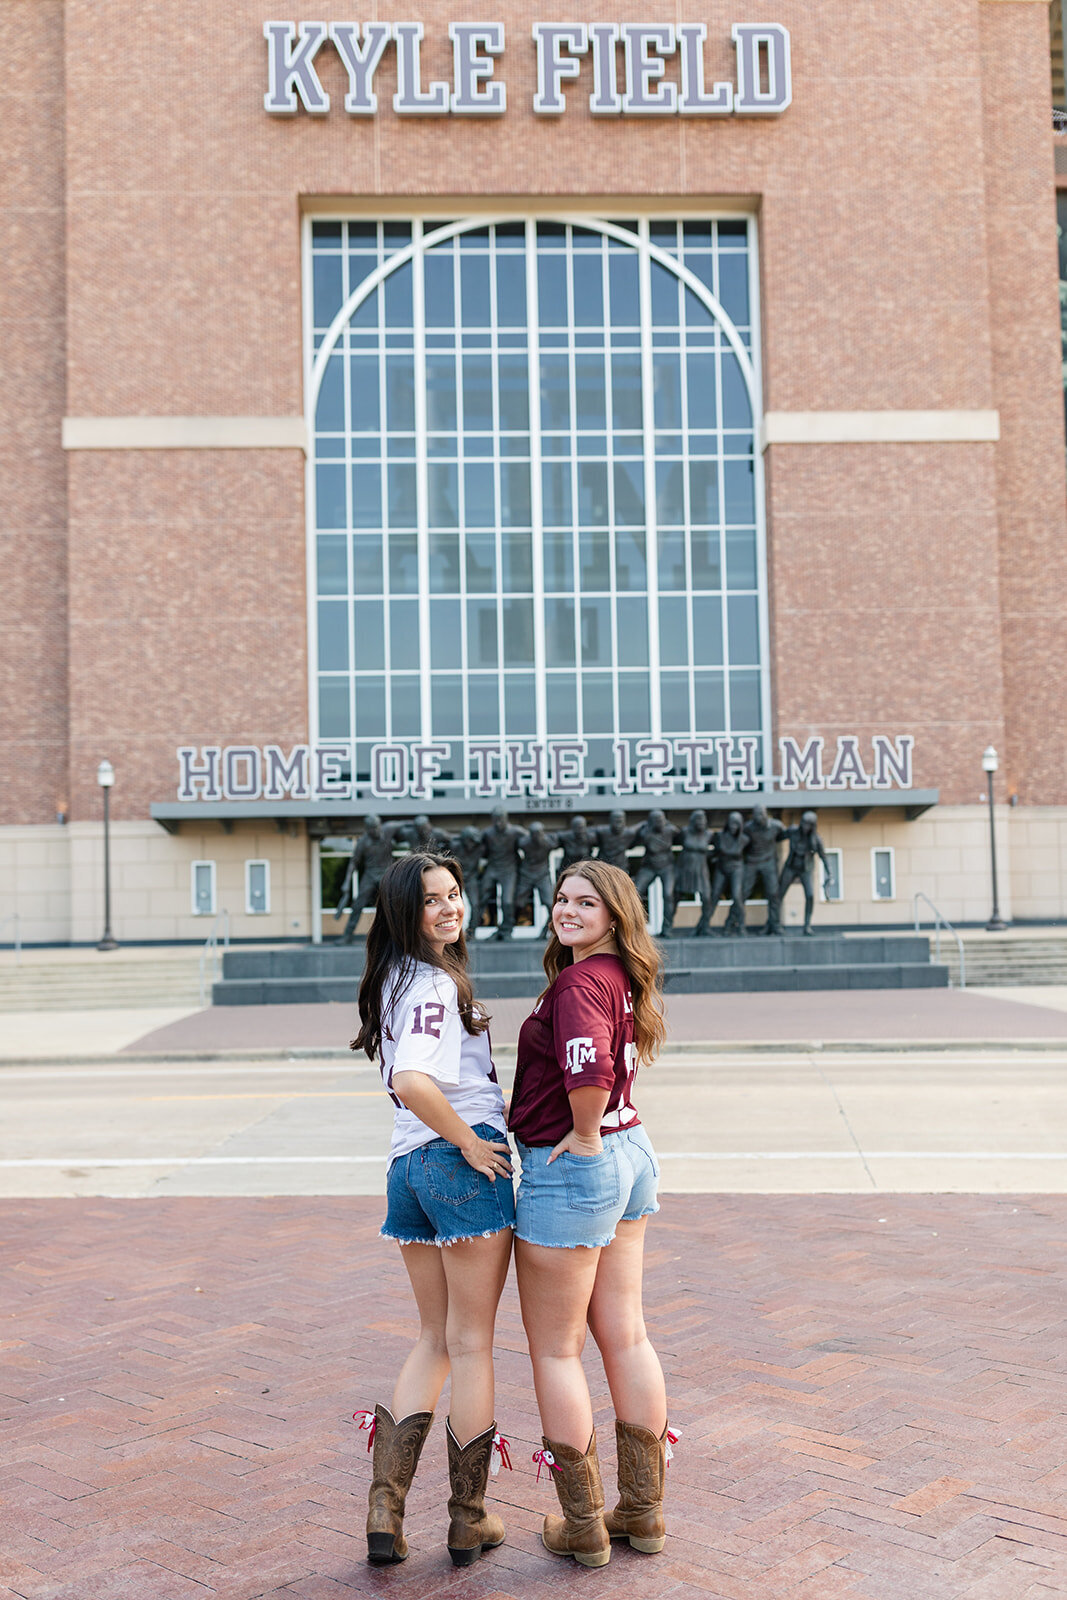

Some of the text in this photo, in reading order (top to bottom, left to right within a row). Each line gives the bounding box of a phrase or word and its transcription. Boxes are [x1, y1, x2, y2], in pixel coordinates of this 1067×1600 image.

[264, 21, 792, 113] KYLE FIELD
[177, 735, 914, 801] HOME OF THE 12TH MAN
[411, 1002, 445, 1039] 12
